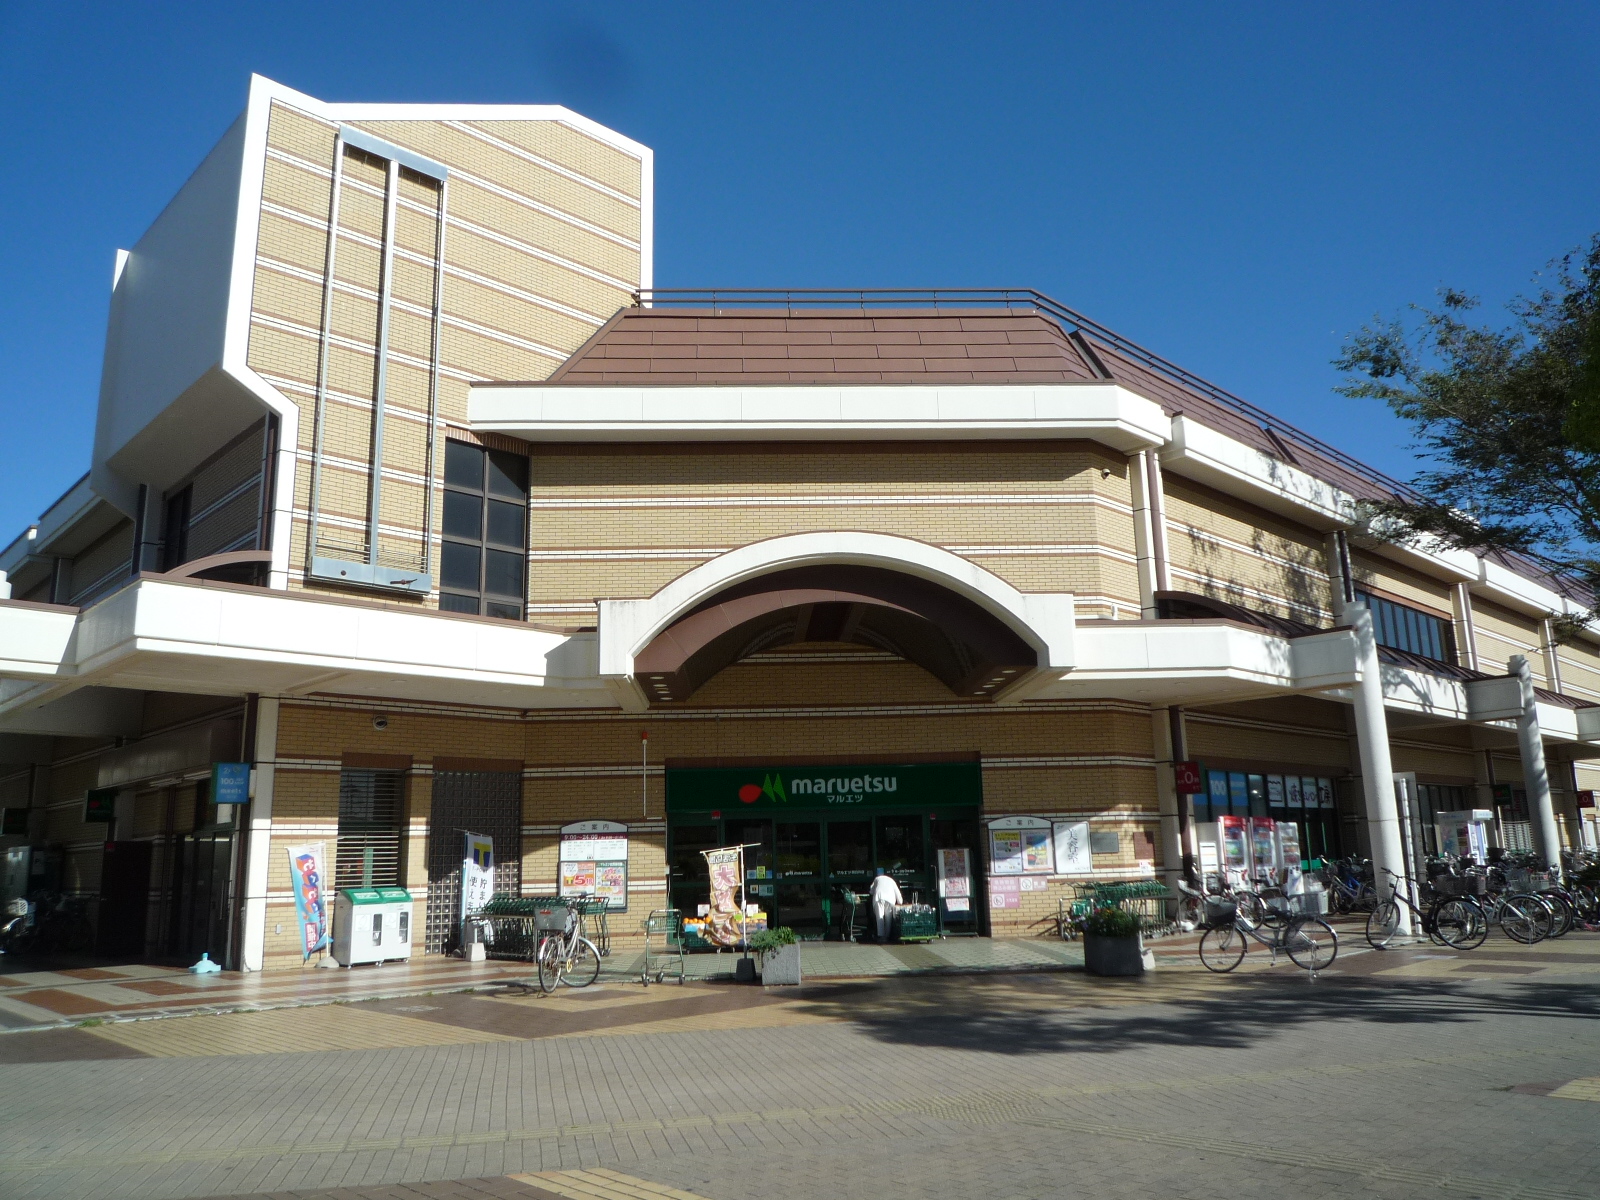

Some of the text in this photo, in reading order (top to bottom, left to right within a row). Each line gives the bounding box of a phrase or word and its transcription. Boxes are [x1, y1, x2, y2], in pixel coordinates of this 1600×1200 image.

[791, 774, 898, 794] maruetsu
[826, 794, 864, 804] マルエツ
[579, 823, 610, 831] ご案内
